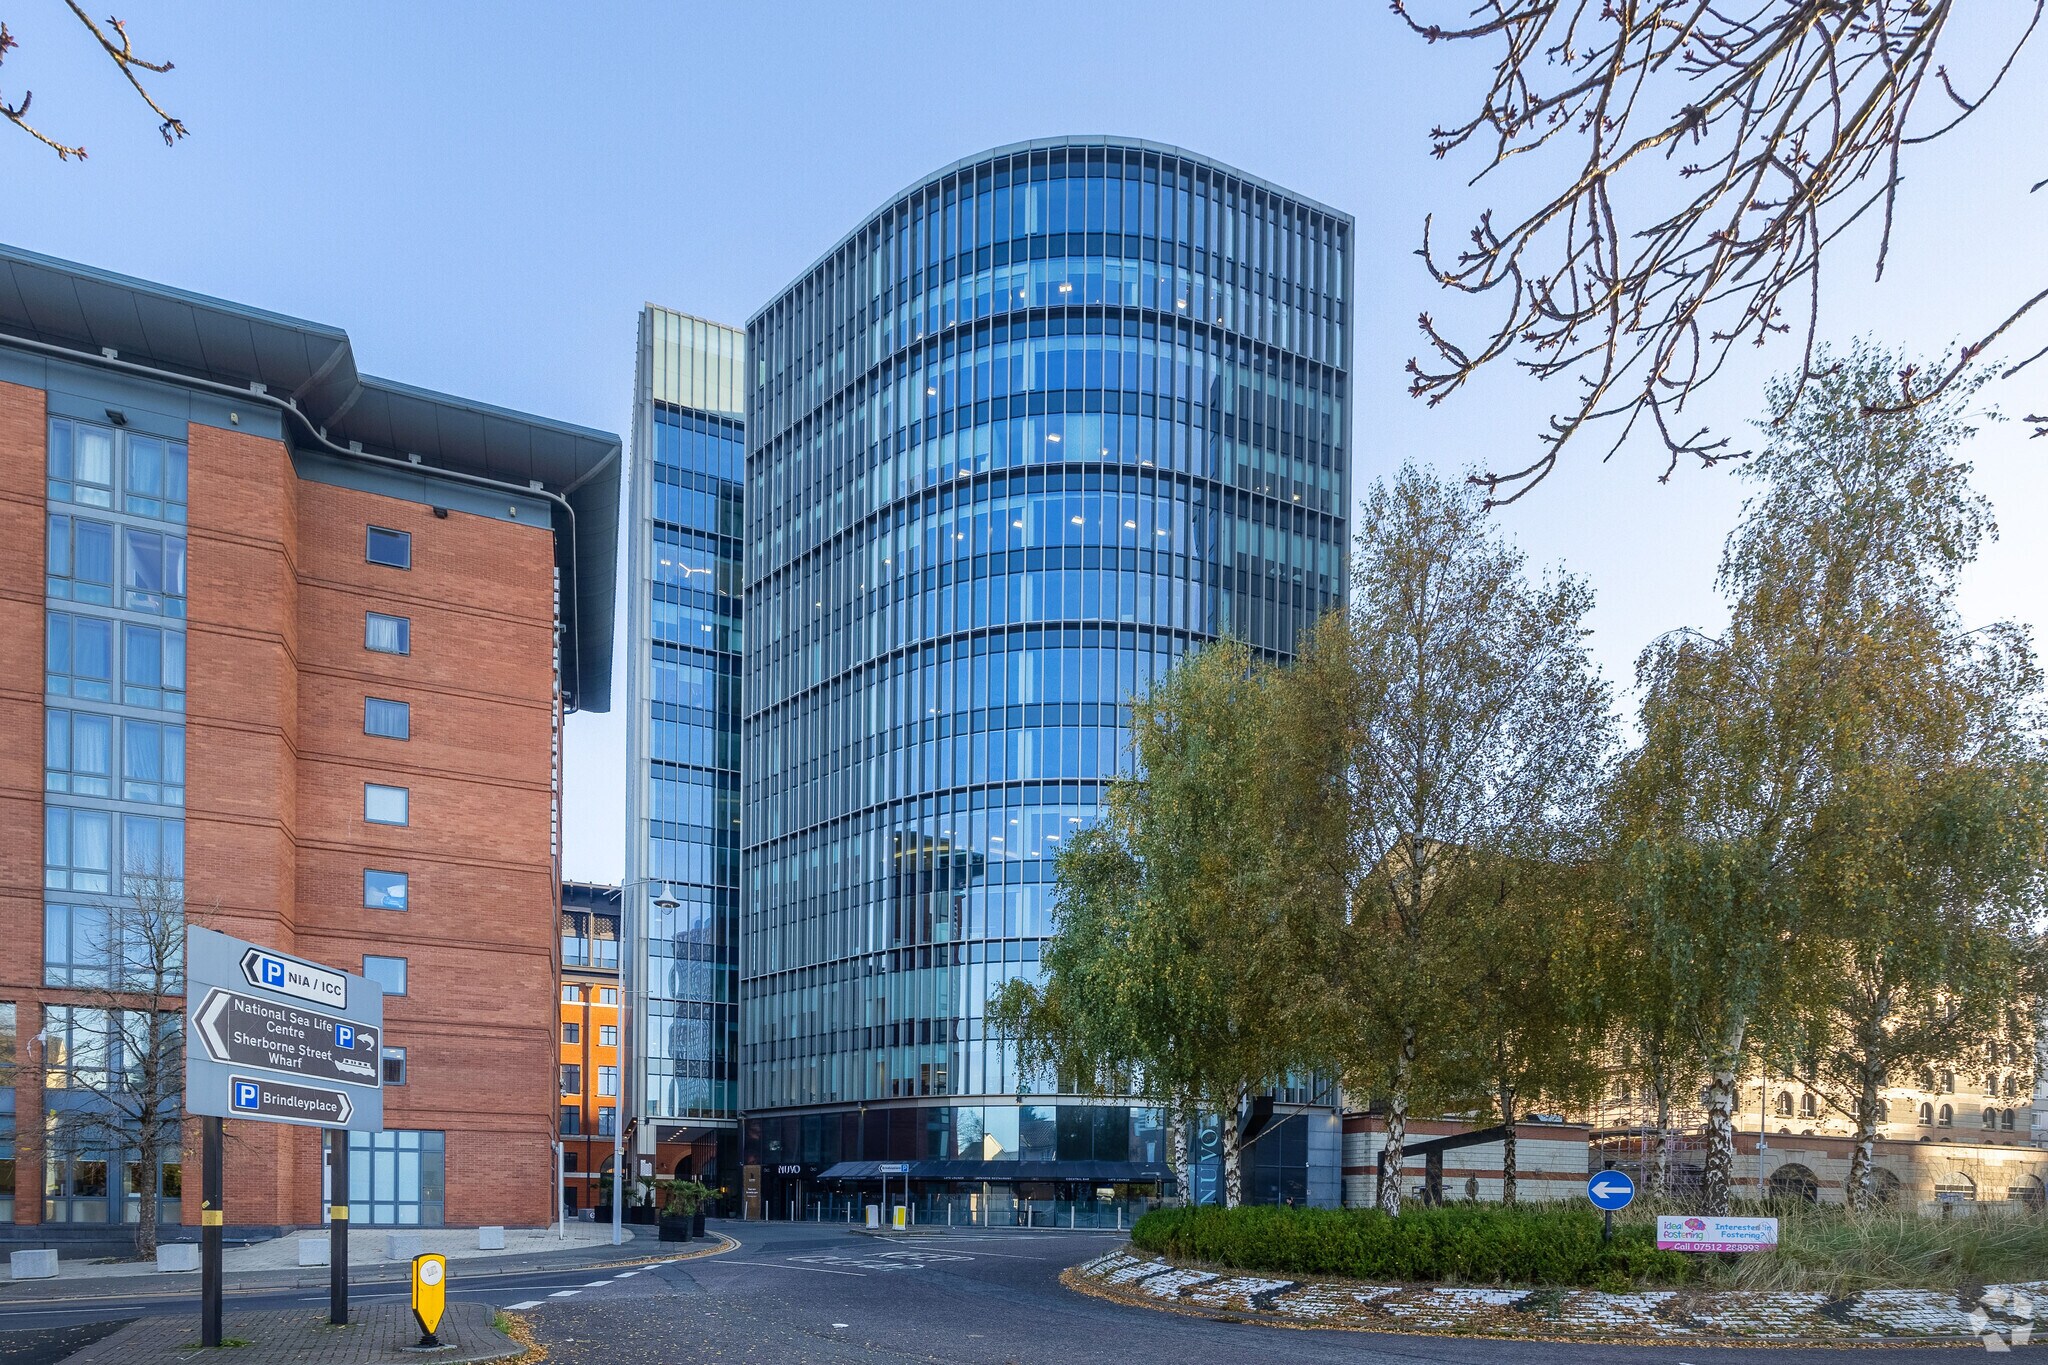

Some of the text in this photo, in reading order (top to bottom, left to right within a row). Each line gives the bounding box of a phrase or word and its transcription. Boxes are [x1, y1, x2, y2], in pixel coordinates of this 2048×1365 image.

[267, 962, 281, 982] P
[288, 972, 310, 988] NIA
[321, 981, 342, 996] ICC
[234, 999, 333, 1032] National Sea Life
[266, 1021, 305, 1039] Centre
[339, 1027, 351, 1045] P
[234, 1032, 332, 1061] Sherborne Street
[268, 1052, 303, 1069] Wharf
[241, 1085, 338, 1112] P Brindleyplace
[778, 1165, 801, 1174] NUVO
[1200, 1129, 1219, 1204] NUVO
[1663, 1221, 1684, 1230] ideal
[1715, 1223, 1761, 1231] Interested
[1663, 1230, 1704, 1241] fostering
[1721, 1231, 1765, 1240] Fostering?
[1693, 1243, 1722, 1251] 07512
